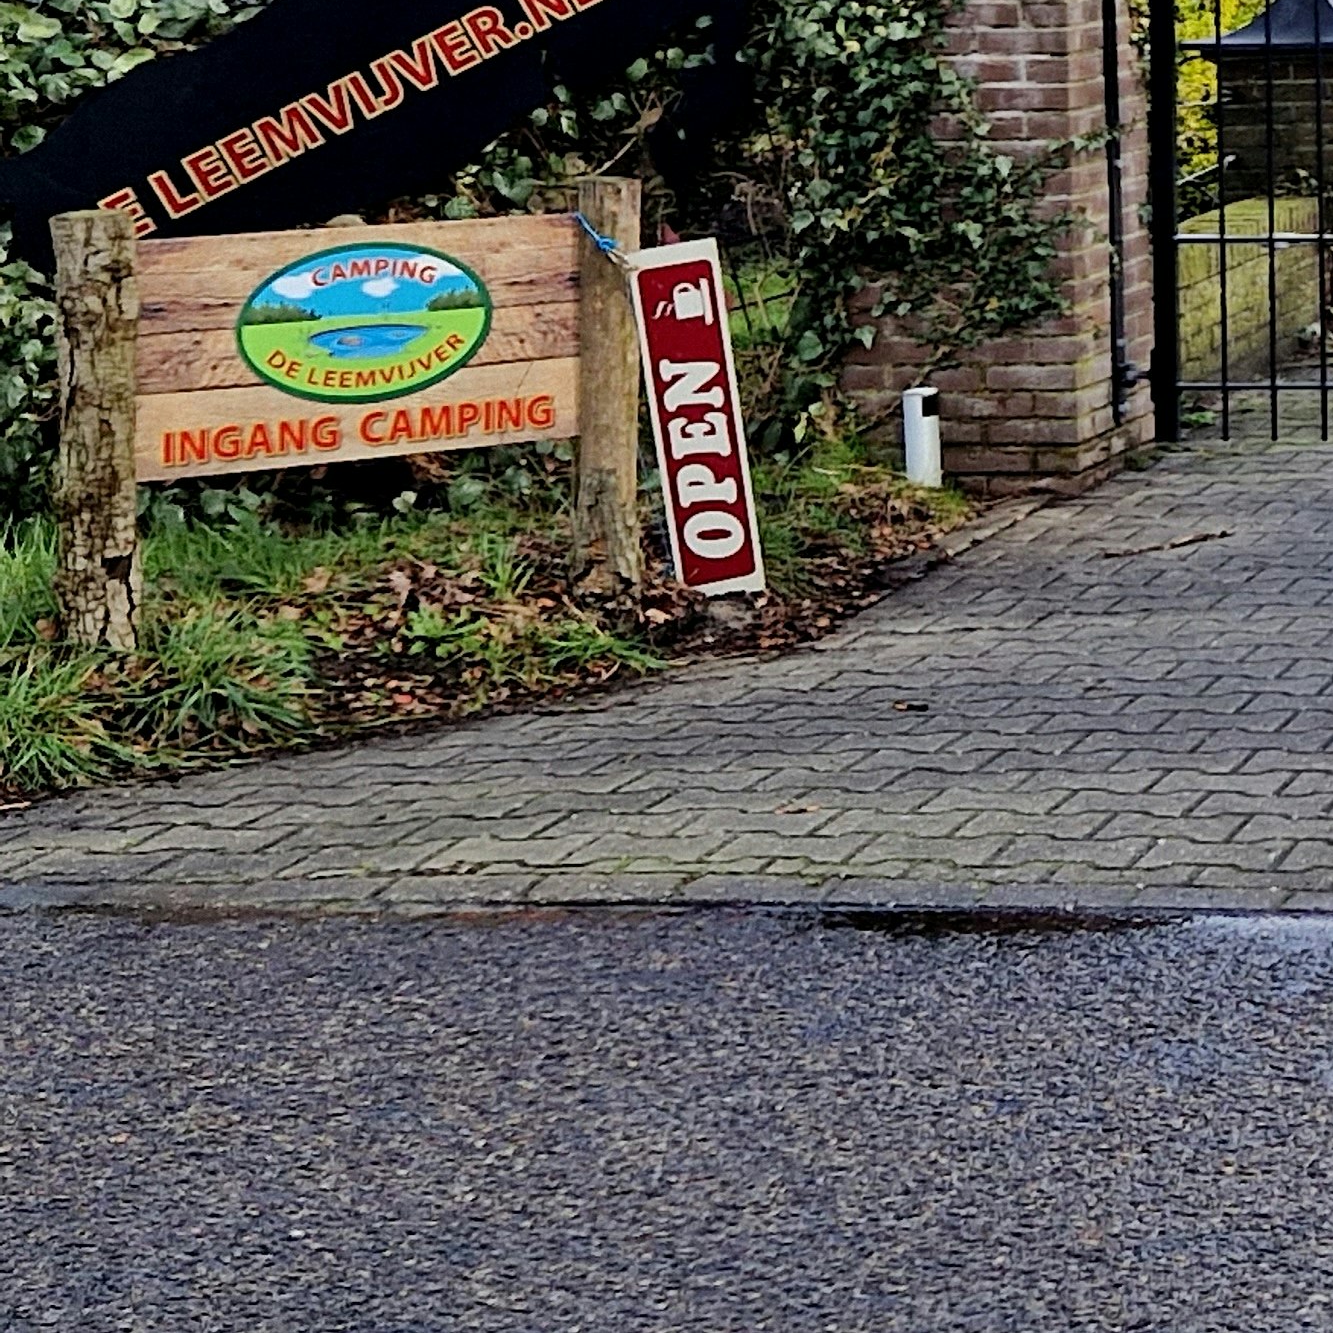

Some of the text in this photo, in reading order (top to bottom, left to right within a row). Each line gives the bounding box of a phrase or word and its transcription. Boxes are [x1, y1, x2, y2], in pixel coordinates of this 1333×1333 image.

[311, 258, 437, 287] CAMPING
[265, 332, 466, 389] DE LEEMVIJVER
[161, 394, 556, 467] INGANG CAMPING
[659, 359, 745, 559] OPEN
